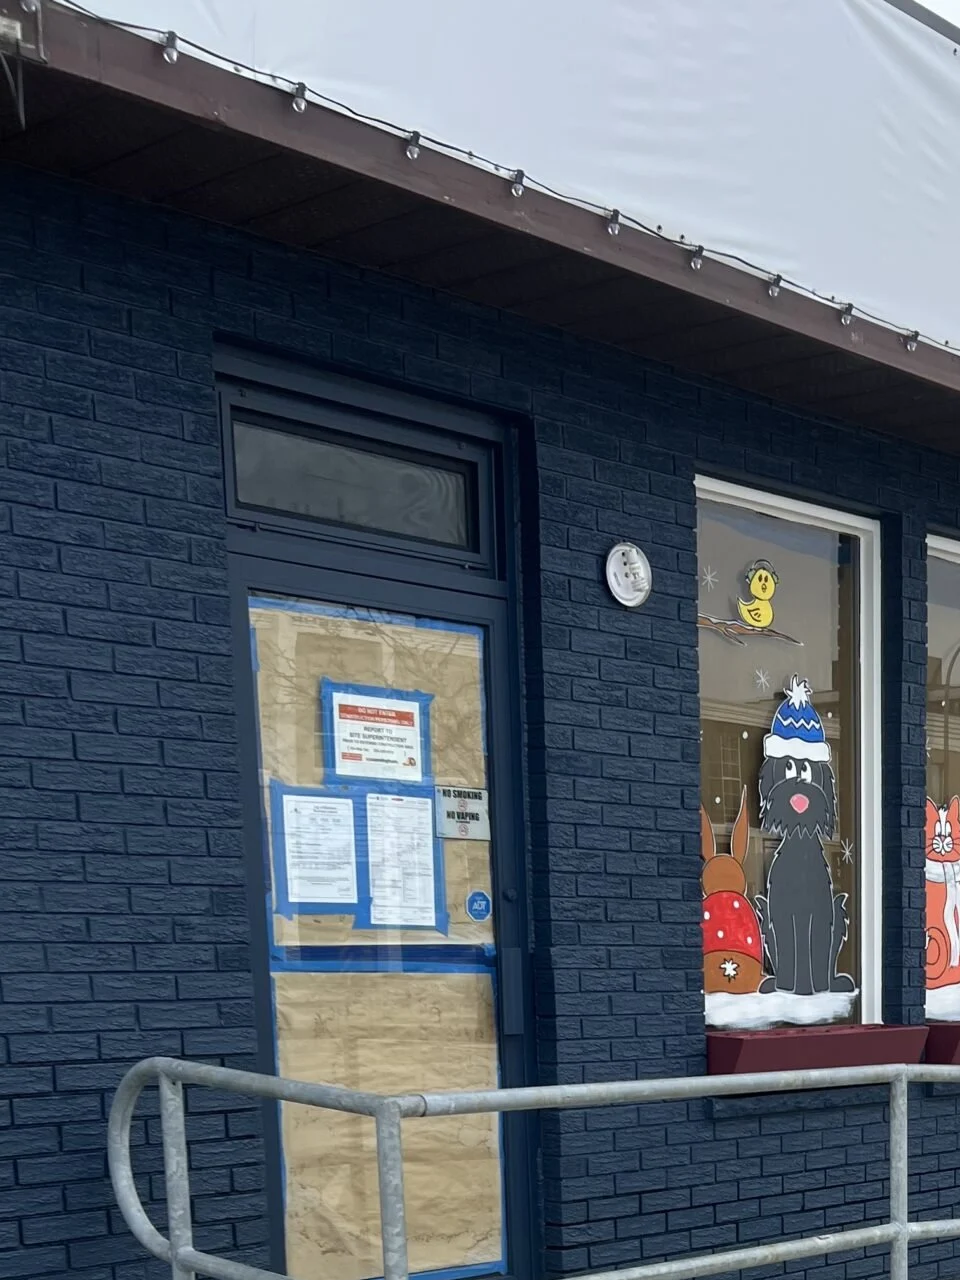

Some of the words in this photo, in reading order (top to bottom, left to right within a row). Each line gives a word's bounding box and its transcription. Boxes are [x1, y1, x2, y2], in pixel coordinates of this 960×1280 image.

[364, 726, 384, 734] REPORT
[362, 733, 407, 743] SUPERINTENDENT
[442, 788, 451, 798] NO
[452, 790, 483, 800] SMOKING
[446, 810, 455, 819] NO
[456, 811, 480, 821] VAPING
[472, 900, 487, 910] ADT
